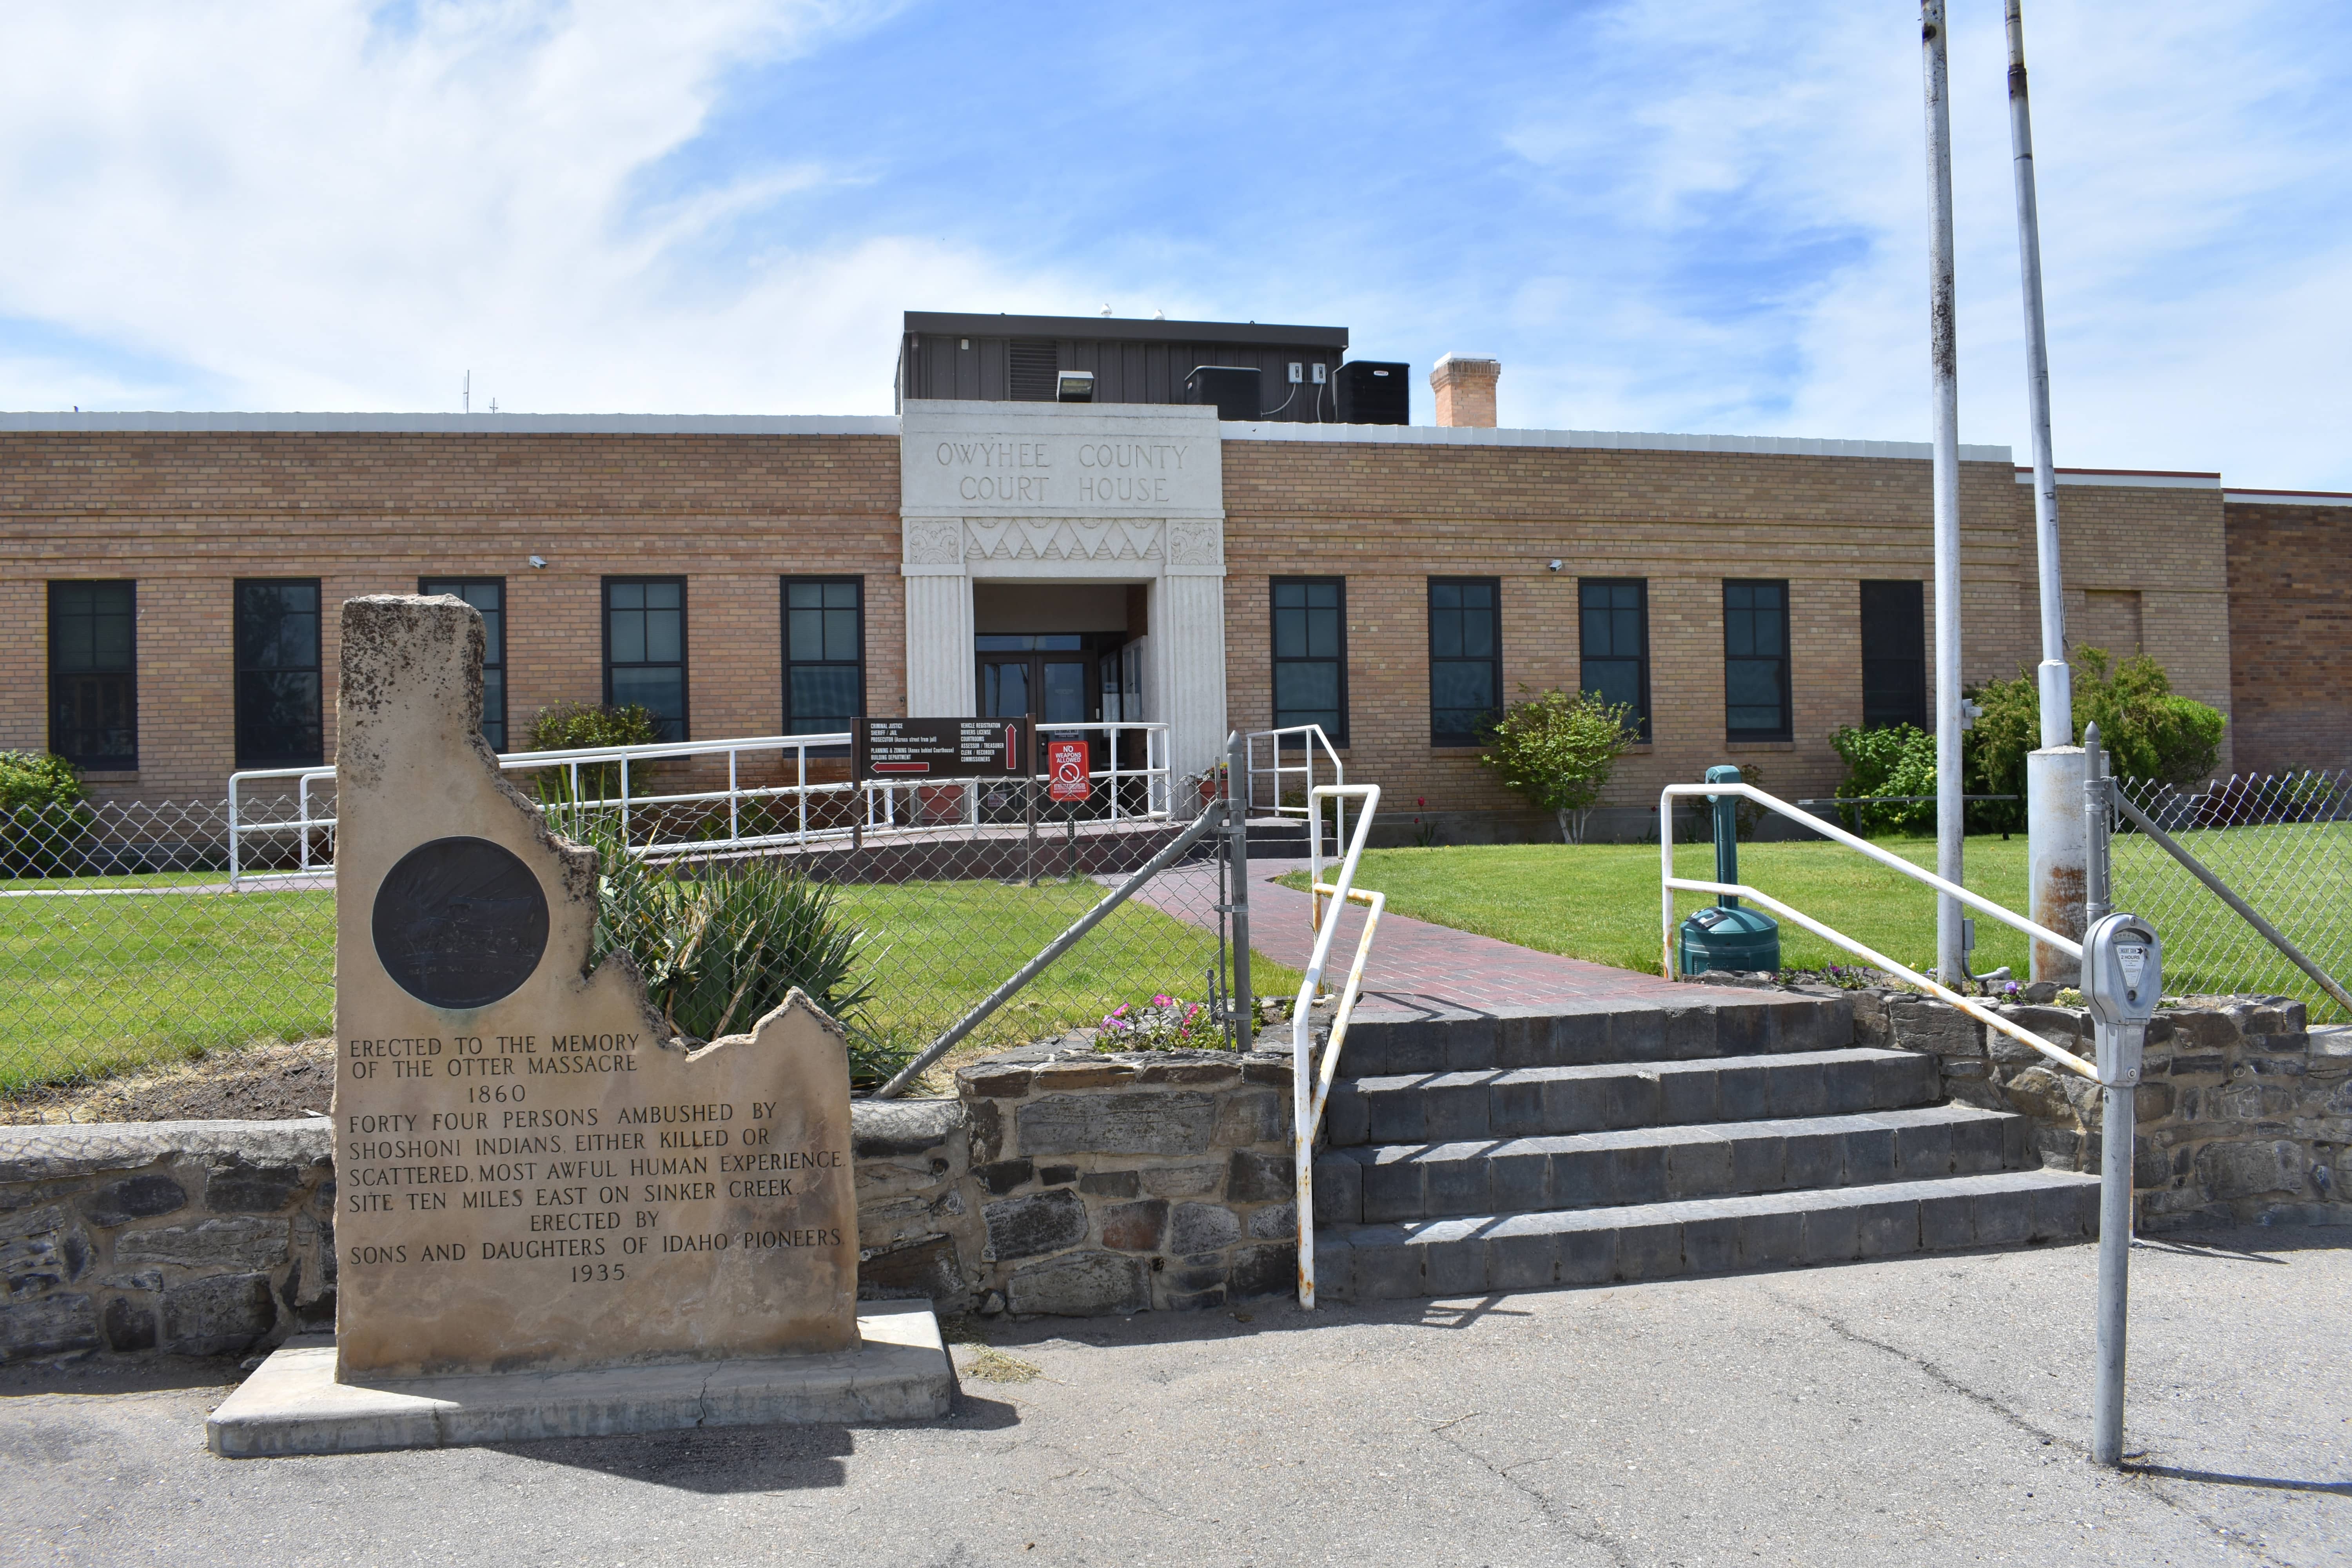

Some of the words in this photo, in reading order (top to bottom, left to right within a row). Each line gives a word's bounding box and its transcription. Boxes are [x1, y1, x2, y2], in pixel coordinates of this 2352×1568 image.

[937, 443, 1051, 467] OWYHEE
[1079, 444, 1188, 469] COUNTY
[960, 476, 1050, 501] COURT
[1079, 477, 1169, 502] HOUSE
[351, 1038, 441, 1057] ERECTED
[454, 1037, 482, 1054] TO
[496, 1036, 536, 1053] THE
[552, 1034, 639, 1052] MEMORY
[353, 1062, 378, 1078] OF
[393, 1060, 433, 1077] THE
[448, 1058, 515, 1076] OTTER
[528, 1055, 637, 1074] MASSACRE
[469, 1085, 525, 1103] 1860
[350, 1114, 417, 1133] FORTY
[433, 1112, 488, 1130] FOUR
[504, 1108, 598, 1128] PERSONS
[618, 1103, 733, 1124] AMBUSHED
[753, 1102, 777, 1119] BY
[350, 1140, 460, 1160] SHOSHONI
[476, 1136, 566, 1155] INDIANS,
[576, 1133, 646, 1152] EITHER
[661, 1129, 728, 1148] KILLED
[743, 1128, 769, 1146] OR
[350, 1165, 473, 1186] SCATTERED,
[480, 1163, 537, 1182] MOST
[547, 1160, 617, 1180] AWFUL
[631, 1157, 706, 1176] HUMAN
[721, 1151, 846, 1172] EXPERIENCE.
[350, 1194, 393, 1212] SITE
[407, 1192, 446, 1210] TEN
[463, 1189, 523, 1208] MILES
[537, 1187, 587, 1206] EAST
[600, 1186, 628, 1204] ON
[645, 1182, 716, 1202] SINKER
[531, 1212, 620, 1232] ERECTED
[636, 1211, 659, 1228] BY
[351, 1245, 406, 1265] SONS
[421, 1243, 465, 1262] AND
[483, 1238, 605, 1260] DAUGHTERS
[623, 1236, 648, 1254] OF
[663, 1233, 728, 1252] IDAHO
